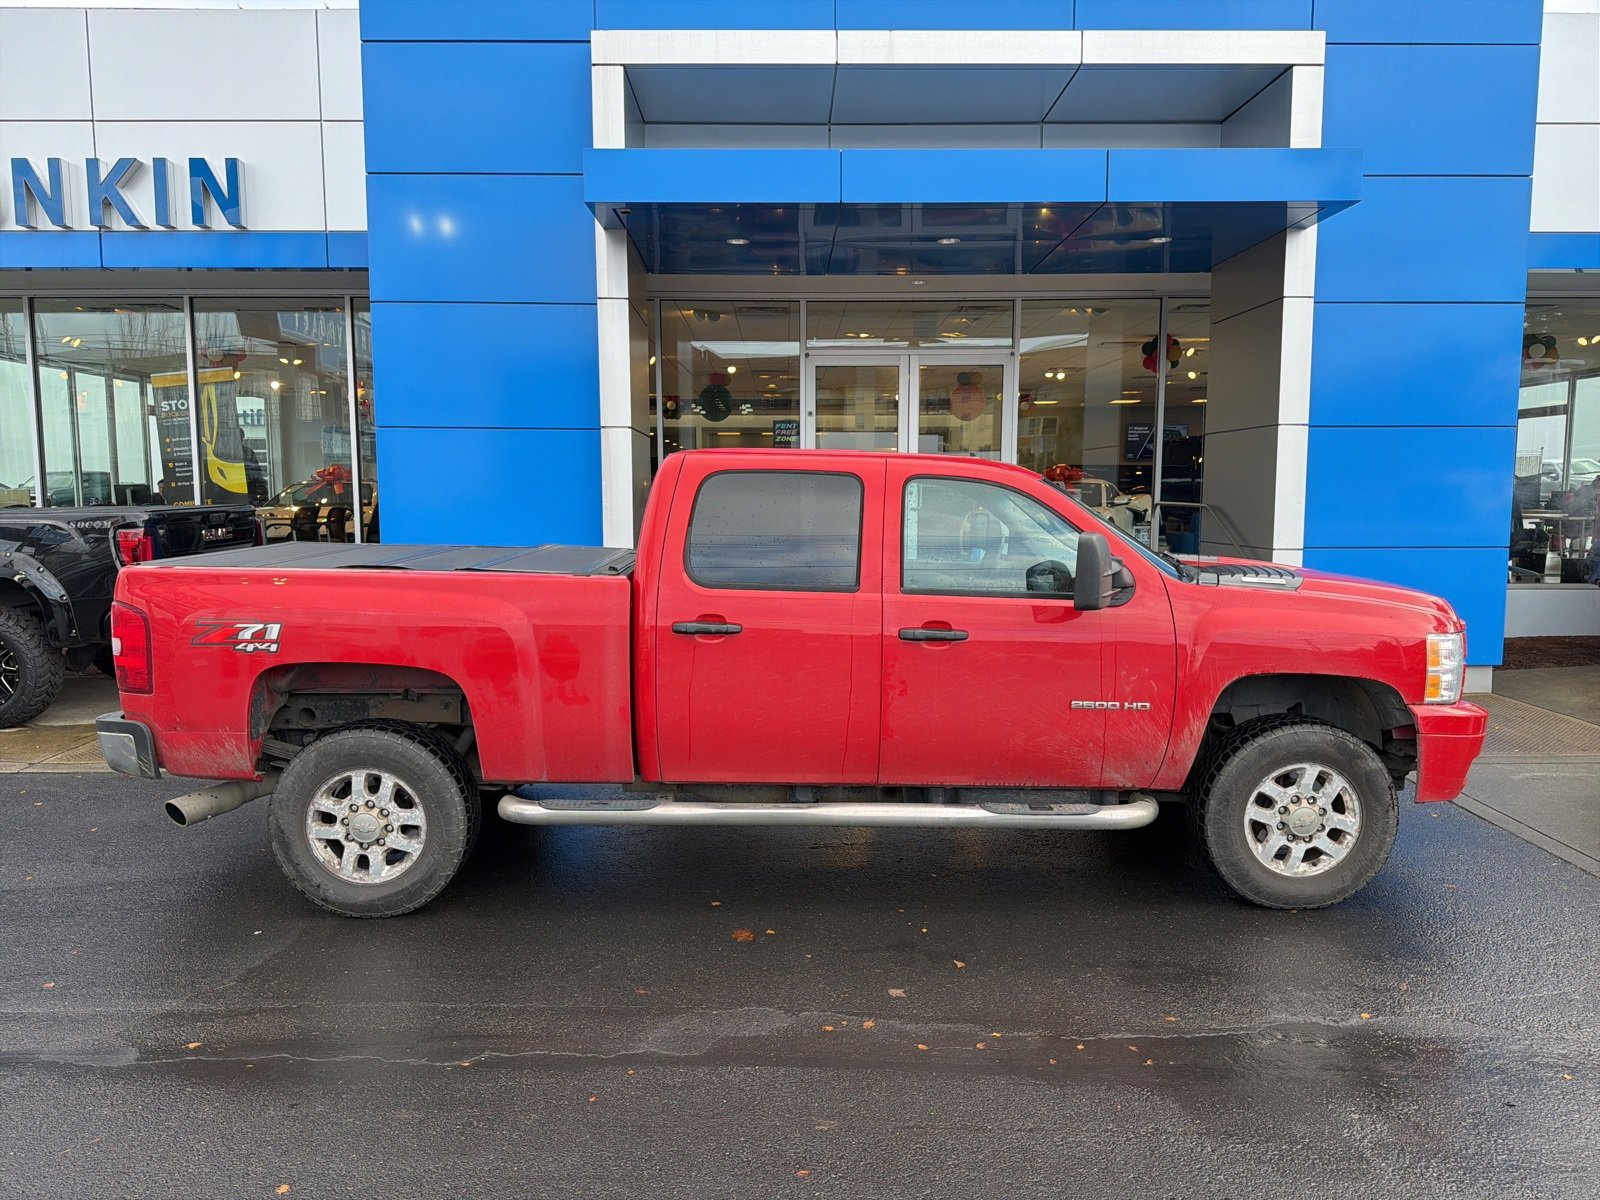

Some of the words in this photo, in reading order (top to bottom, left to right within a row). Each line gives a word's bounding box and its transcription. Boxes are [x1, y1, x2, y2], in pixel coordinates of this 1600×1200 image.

[0, 156, 248, 229] NKIN
[161, 399, 188, 411] STO
[201, 526, 234, 541] GMC
[191, 618, 283, 646] Z71
[1070, 700, 1120, 710] 2500
[1123, 701, 1151, 711] HD
